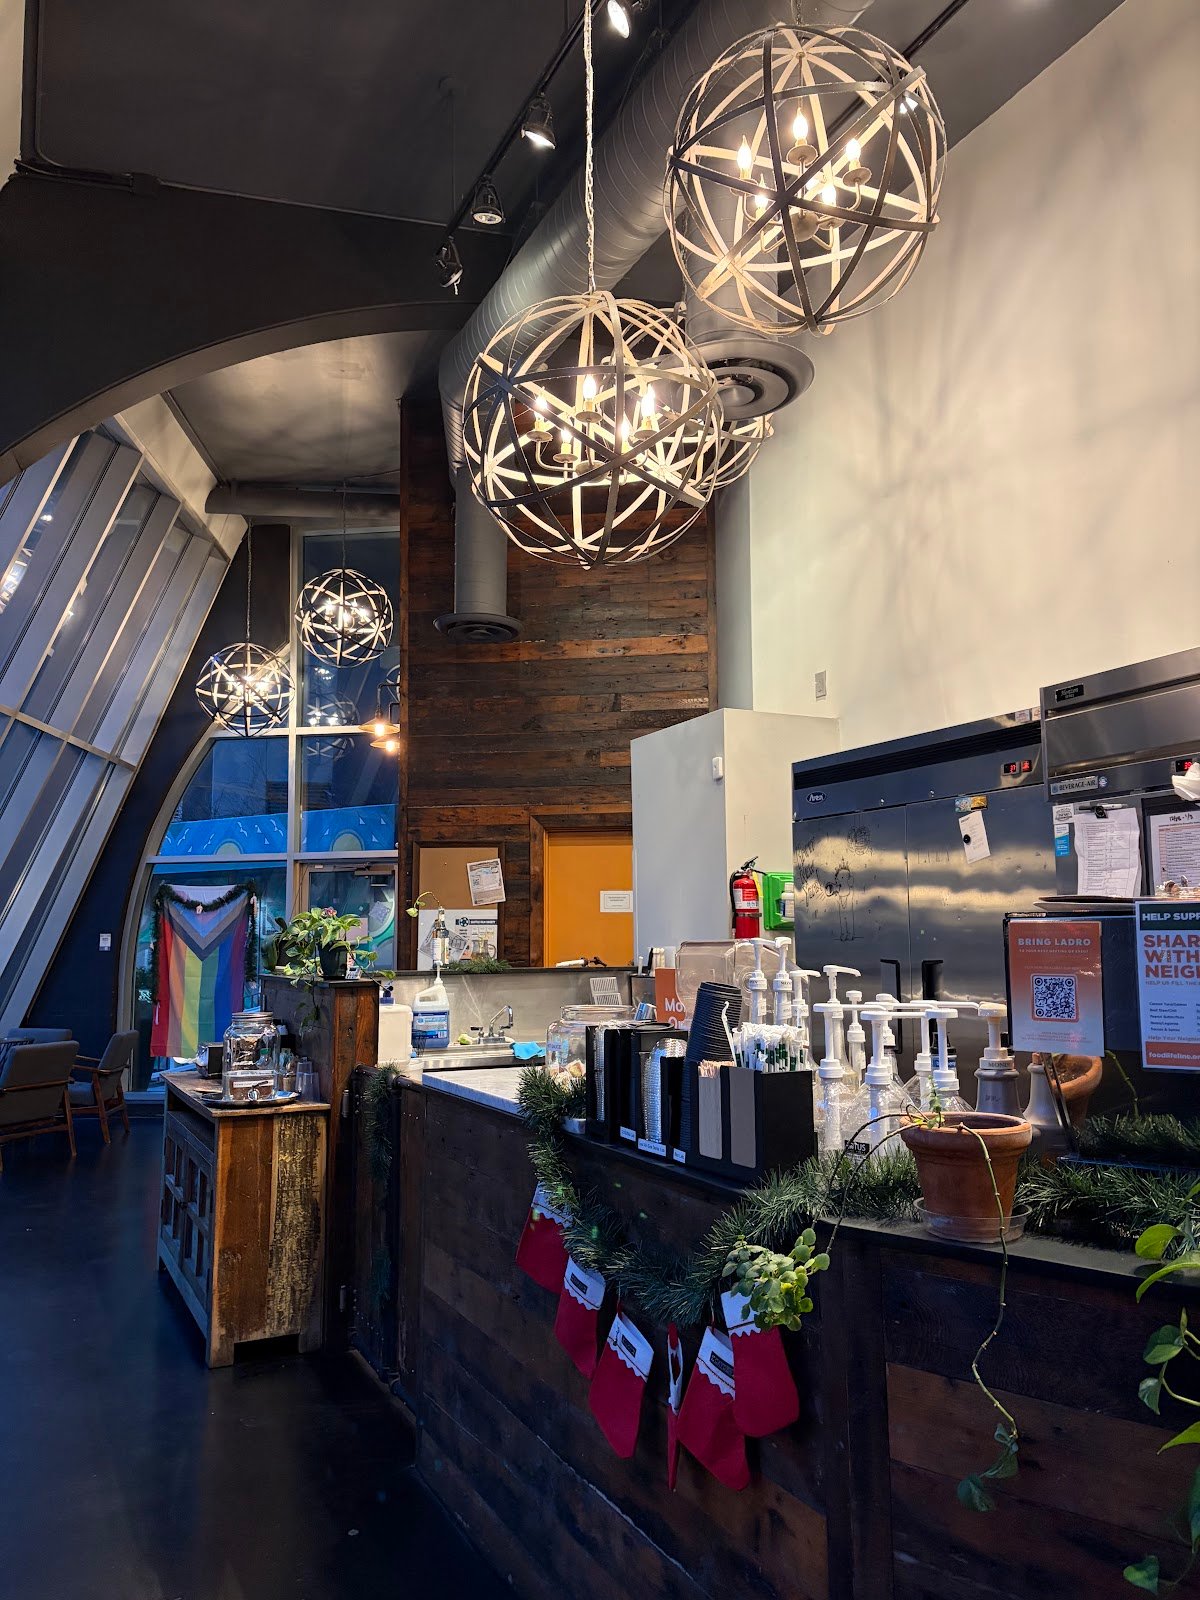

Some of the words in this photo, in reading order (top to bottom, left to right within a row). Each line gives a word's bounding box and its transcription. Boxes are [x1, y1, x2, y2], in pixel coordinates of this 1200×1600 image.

[1142, 913, 1171, 921] HELP
[1018, 938, 1051, 946] BRING
[1054, 938, 1091, 946] LADRO
[1143, 934, 1200, 948] SHAR
[1144, 950, 1200, 963] WITH
[1145, 964, 1200, 979] NEIG
